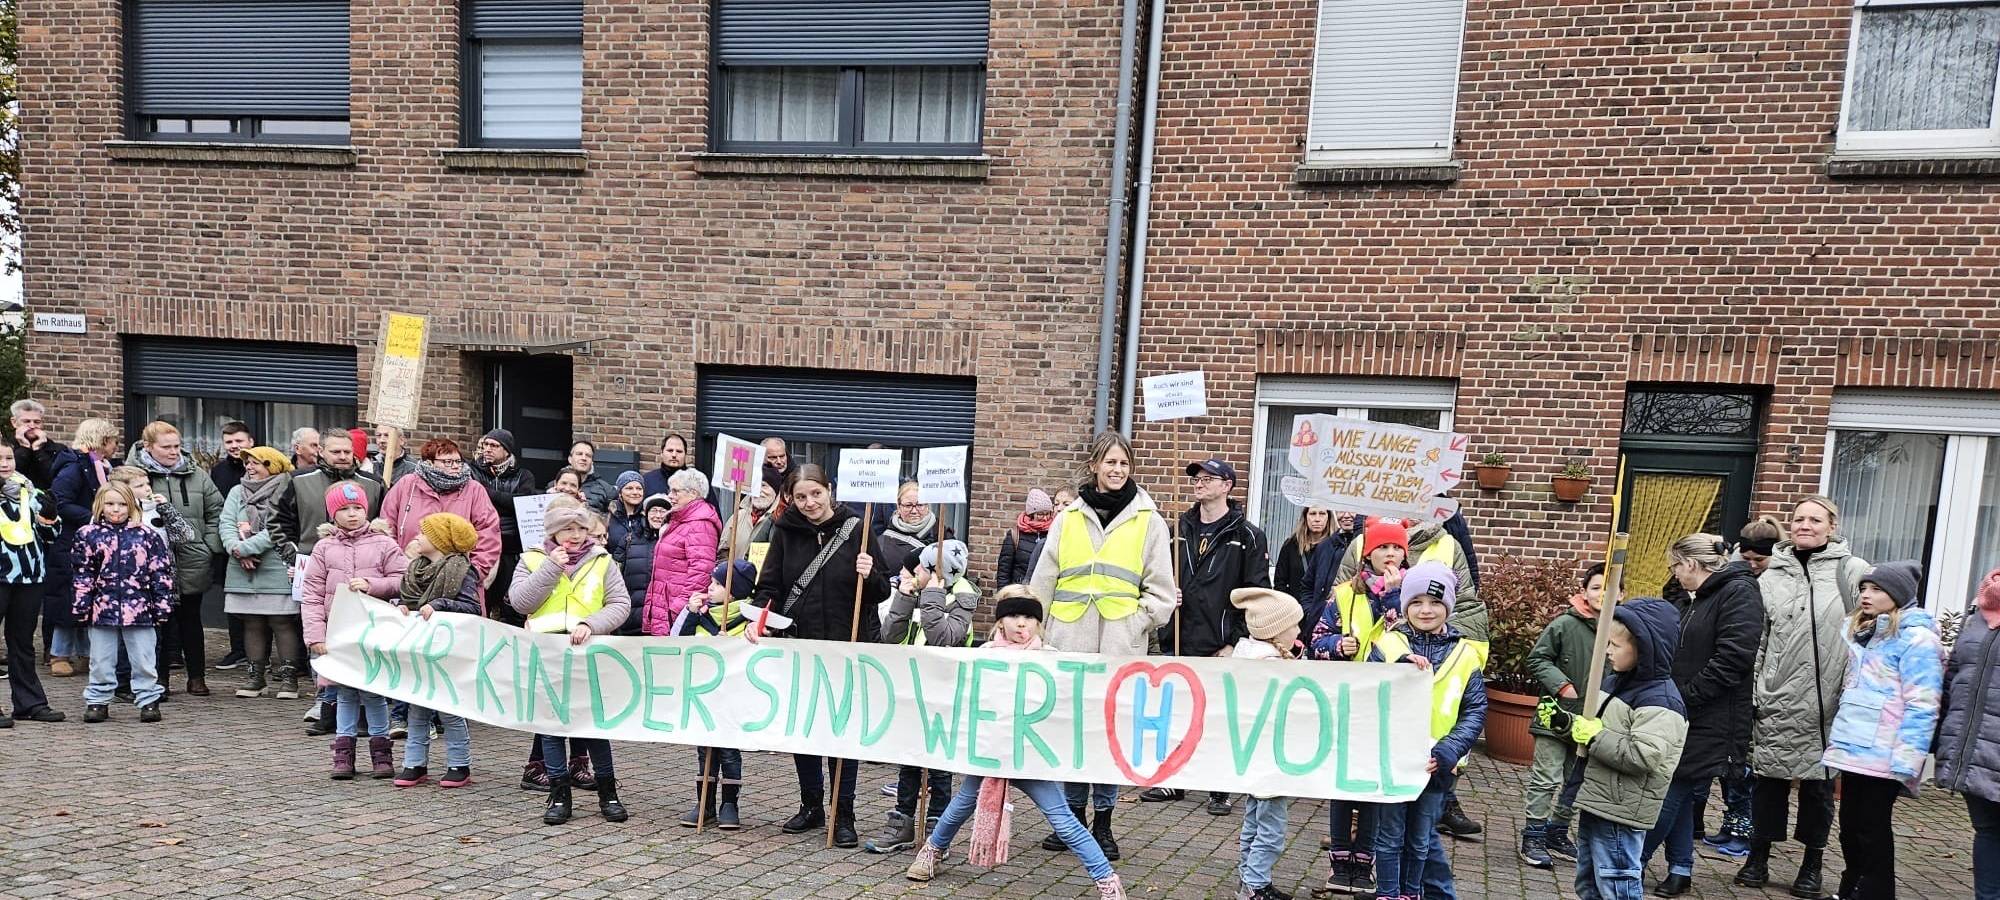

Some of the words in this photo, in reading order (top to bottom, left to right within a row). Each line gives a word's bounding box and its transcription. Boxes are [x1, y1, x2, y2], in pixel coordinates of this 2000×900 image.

[36, 316, 48, 326] Am
[51, 317, 82, 328] Rathaus
[1170, 380, 1179, 388] wir
[1333, 428, 1366, 448] WIE
[1368, 432, 1422, 453] LANGE
[849, 457, 864, 465] Auch
[1335, 449, 1388, 468] MÜSSEN
[1389, 457, 1416, 474] WIR
[1323, 466, 1360, 480] NOCH
[1361, 470, 1393, 484] AUF
[1393, 475, 1424, 490] DEM
[1327, 481, 1365, 497] FLUR
[358, 609, 459, 705] WIR
[476, 624, 725, 732] KINDER
[742, 648, 895, 746] SIND
[1222, 671, 1422, 796] VOLL
